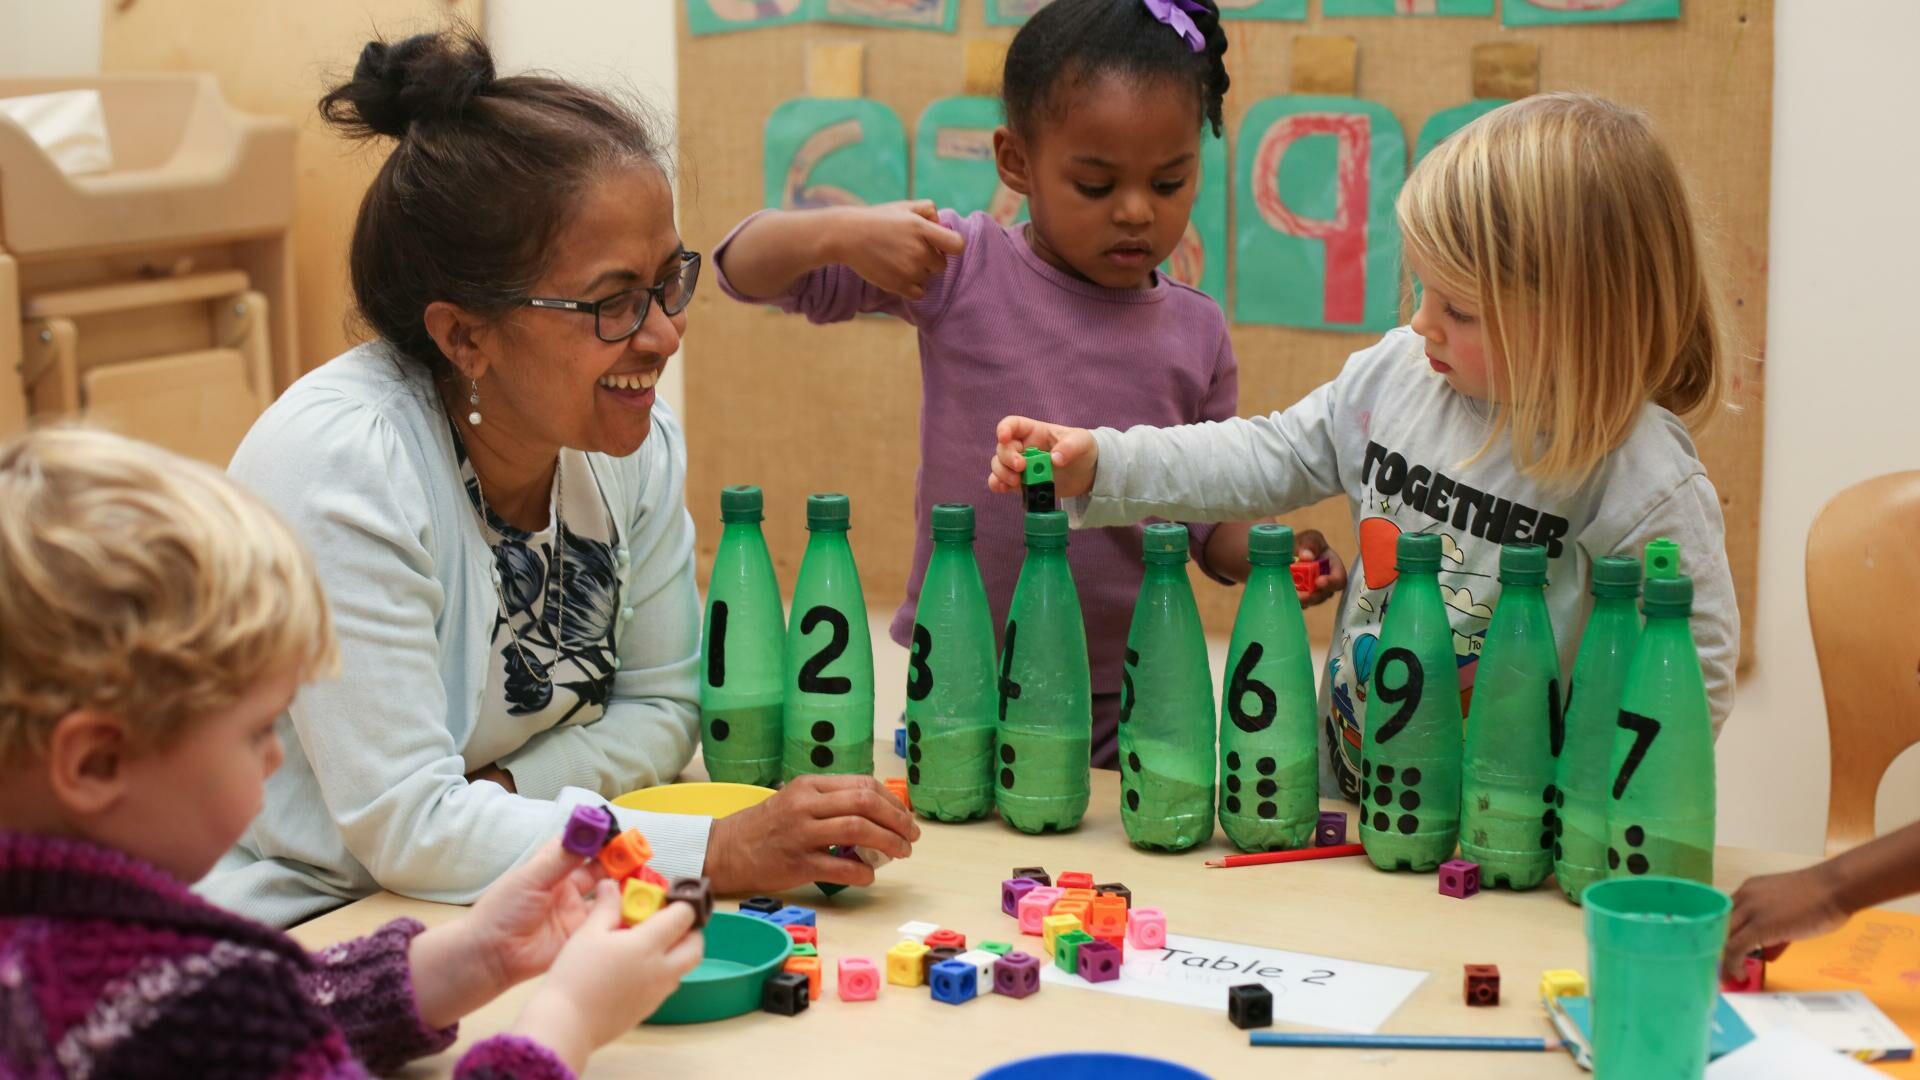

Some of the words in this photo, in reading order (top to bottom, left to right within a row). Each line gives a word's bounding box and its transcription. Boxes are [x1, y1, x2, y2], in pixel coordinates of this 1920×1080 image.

[1361, 440, 1569, 559] TOGETHER
[708, 600, 729, 688] 1
[798, 605, 852, 695] 2
[906, 623, 933, 701] 3
[1228, 641, 1277, 733] 6
[1374, 647, 1425, 744] 9
[1612, 708, 1661, 800] 7
[1160, 946, 1284, 978] Table
[1301, 969, 1336, 986] 2
